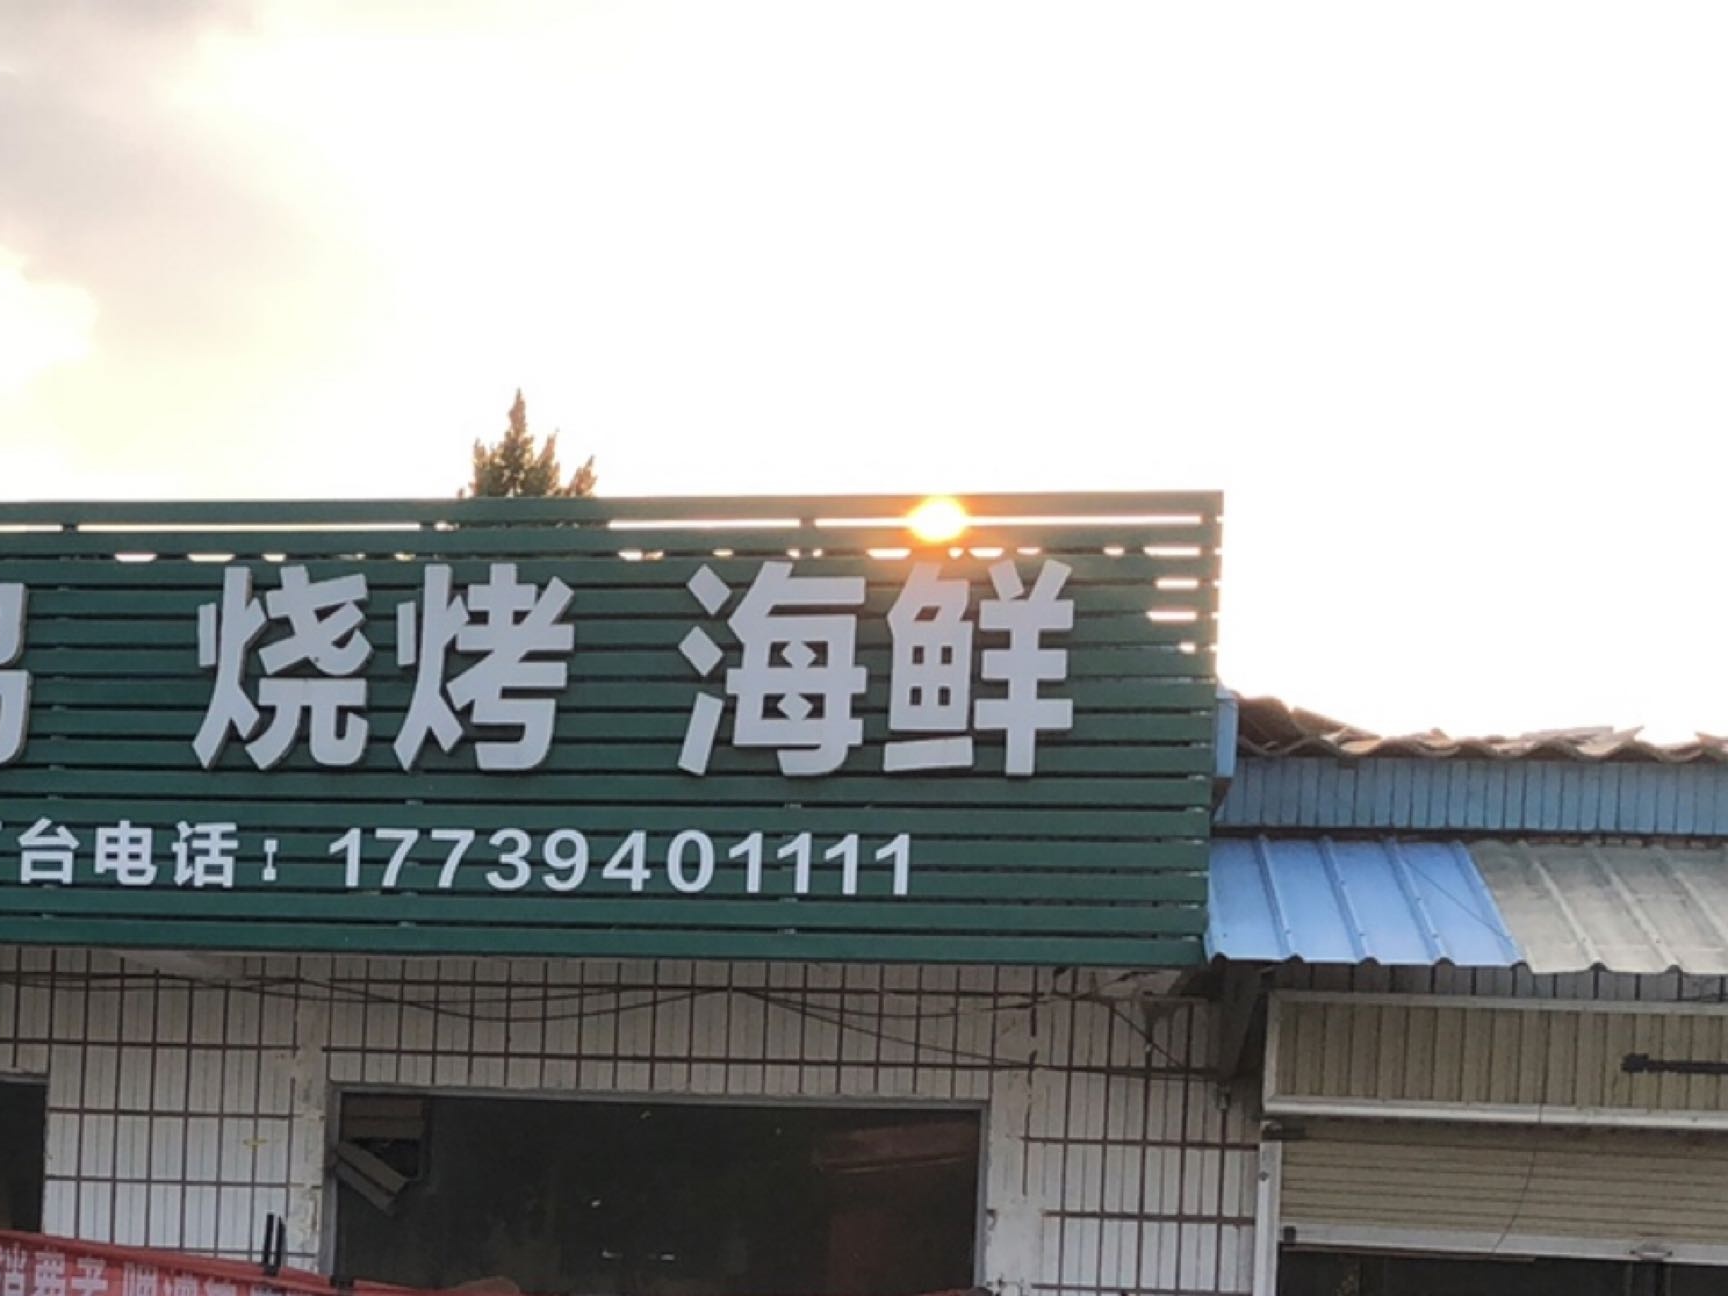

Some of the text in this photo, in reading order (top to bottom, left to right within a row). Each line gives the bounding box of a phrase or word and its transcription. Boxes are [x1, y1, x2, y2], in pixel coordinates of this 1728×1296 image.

[192, 563, 576, 772] 烧烤
[677, 559, 1073, 776] 海鲜
[328, 828, 913, 897] 17739401111
